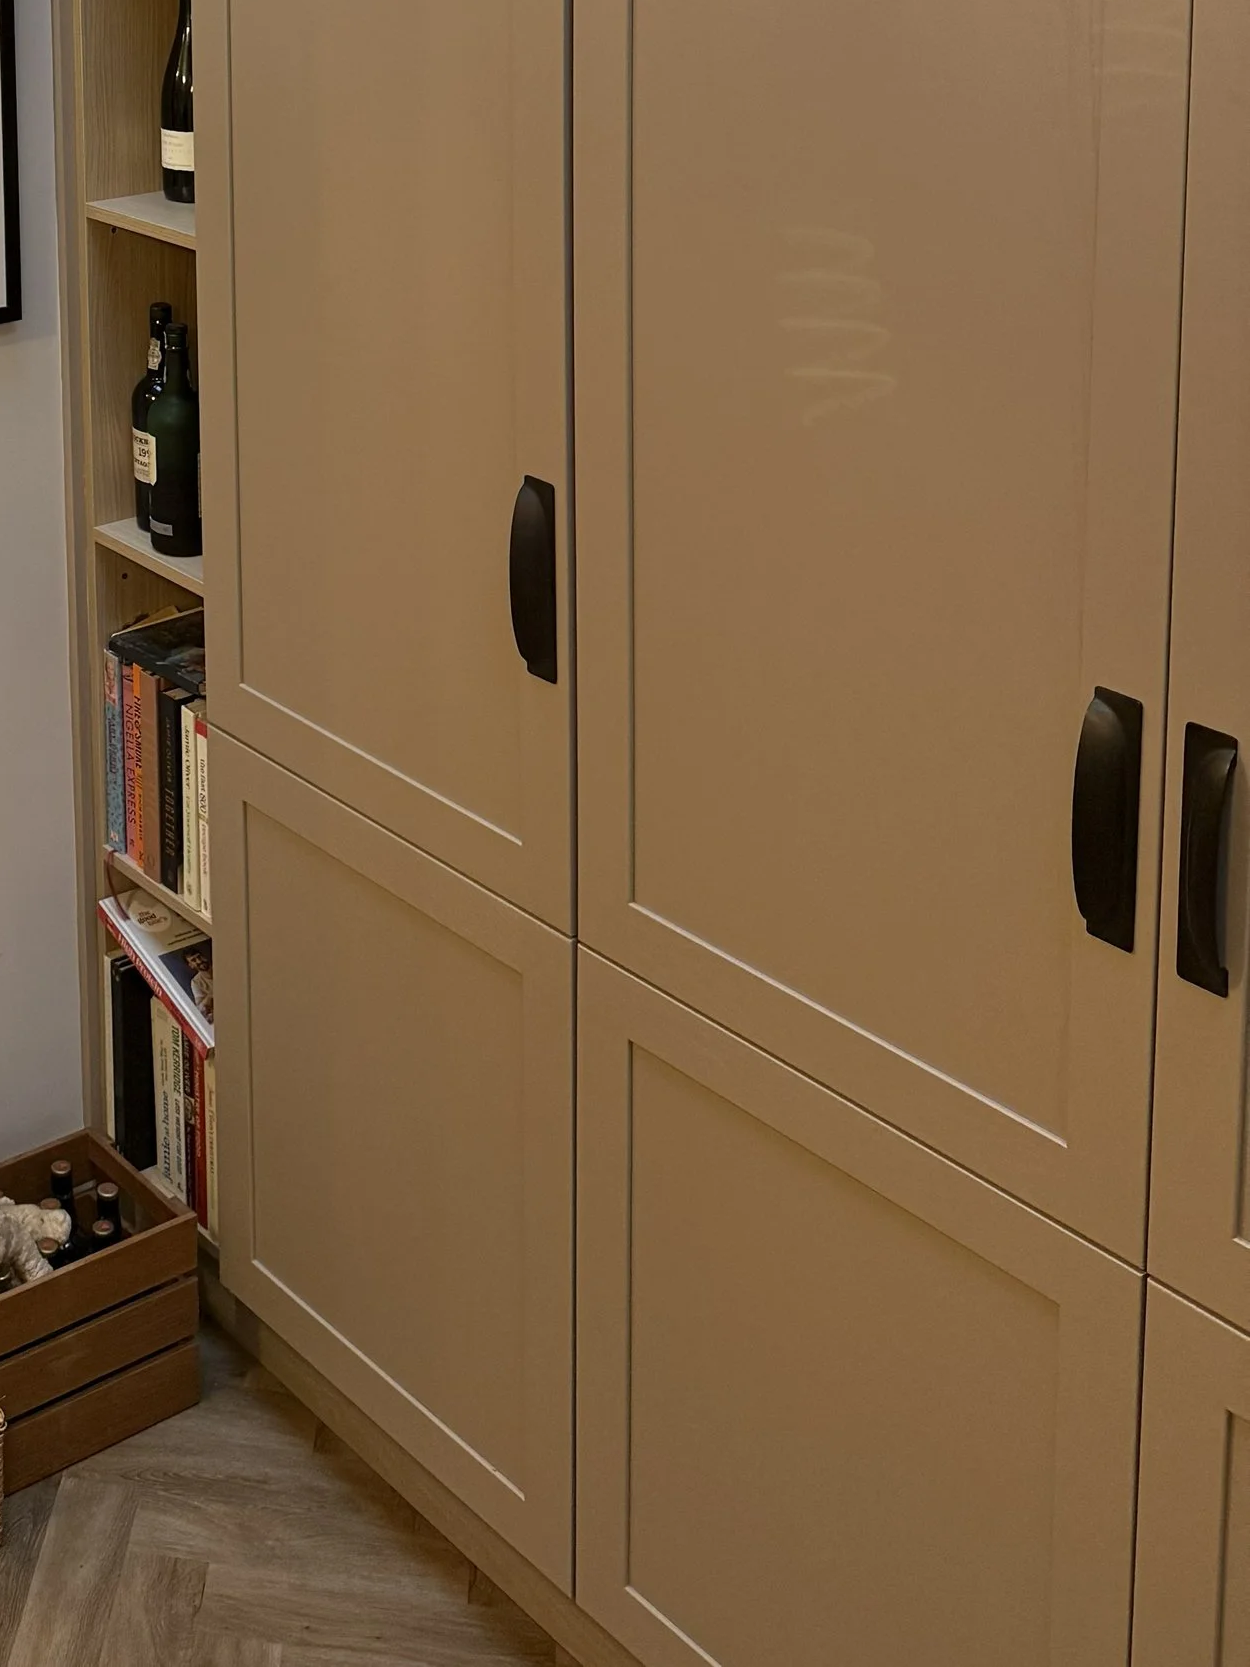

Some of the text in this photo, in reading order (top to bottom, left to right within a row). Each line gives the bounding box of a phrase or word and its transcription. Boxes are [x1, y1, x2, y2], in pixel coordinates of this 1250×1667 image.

[124, 703, 136, 824] NIGELLA EXPRESS
[165, 787, 175, 857] TOGETHER
[171, 1025, 180, 1046] TOM
[172, 1046, 181, 1097] KERRIDGE
